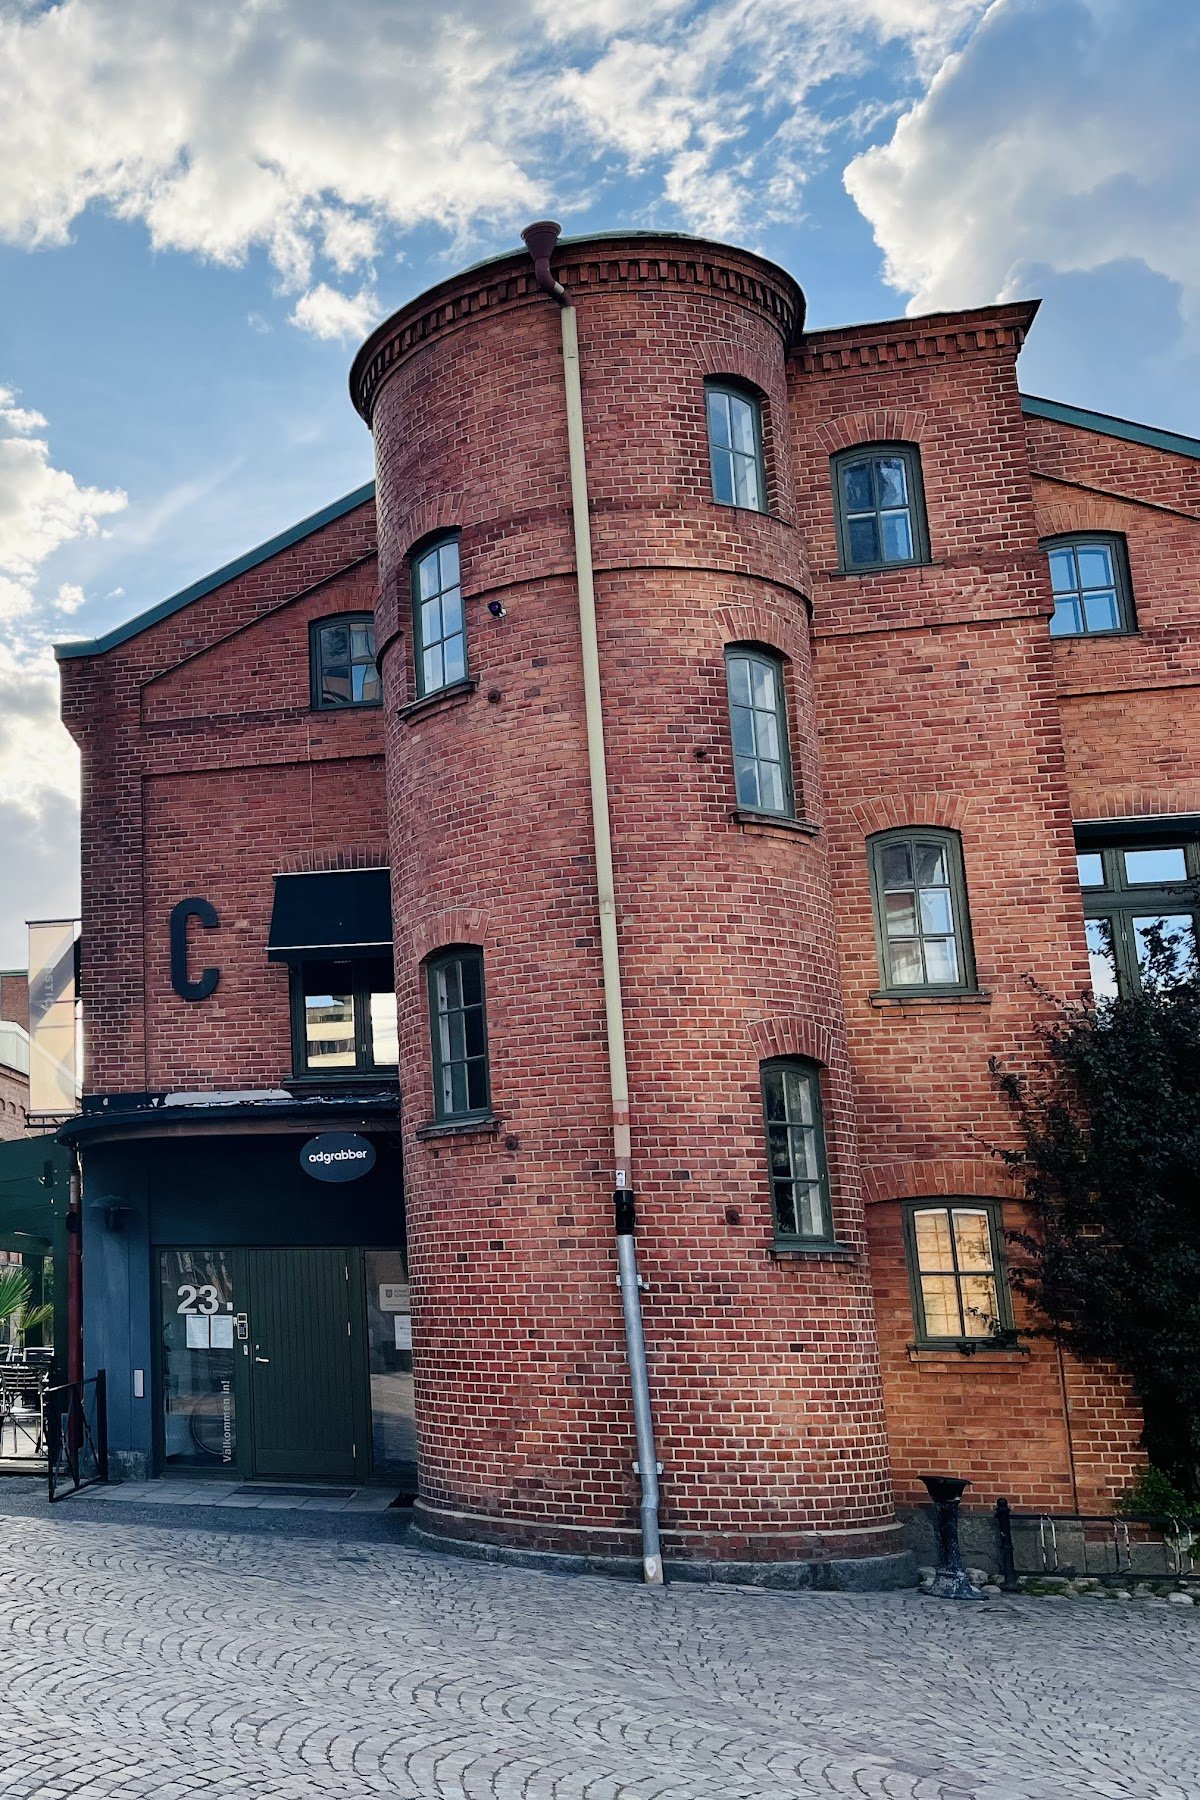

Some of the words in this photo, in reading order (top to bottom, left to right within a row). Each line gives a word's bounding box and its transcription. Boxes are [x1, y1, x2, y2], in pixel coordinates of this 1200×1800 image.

[170, 897, 219, 1001] C
[308, 1148, 367, 1164] adgrabber
[177, 1284, 219, 1314] 23
[221, 1380, 230, 1394] in!
[222, 1398, 232, 1463] Välkommen
